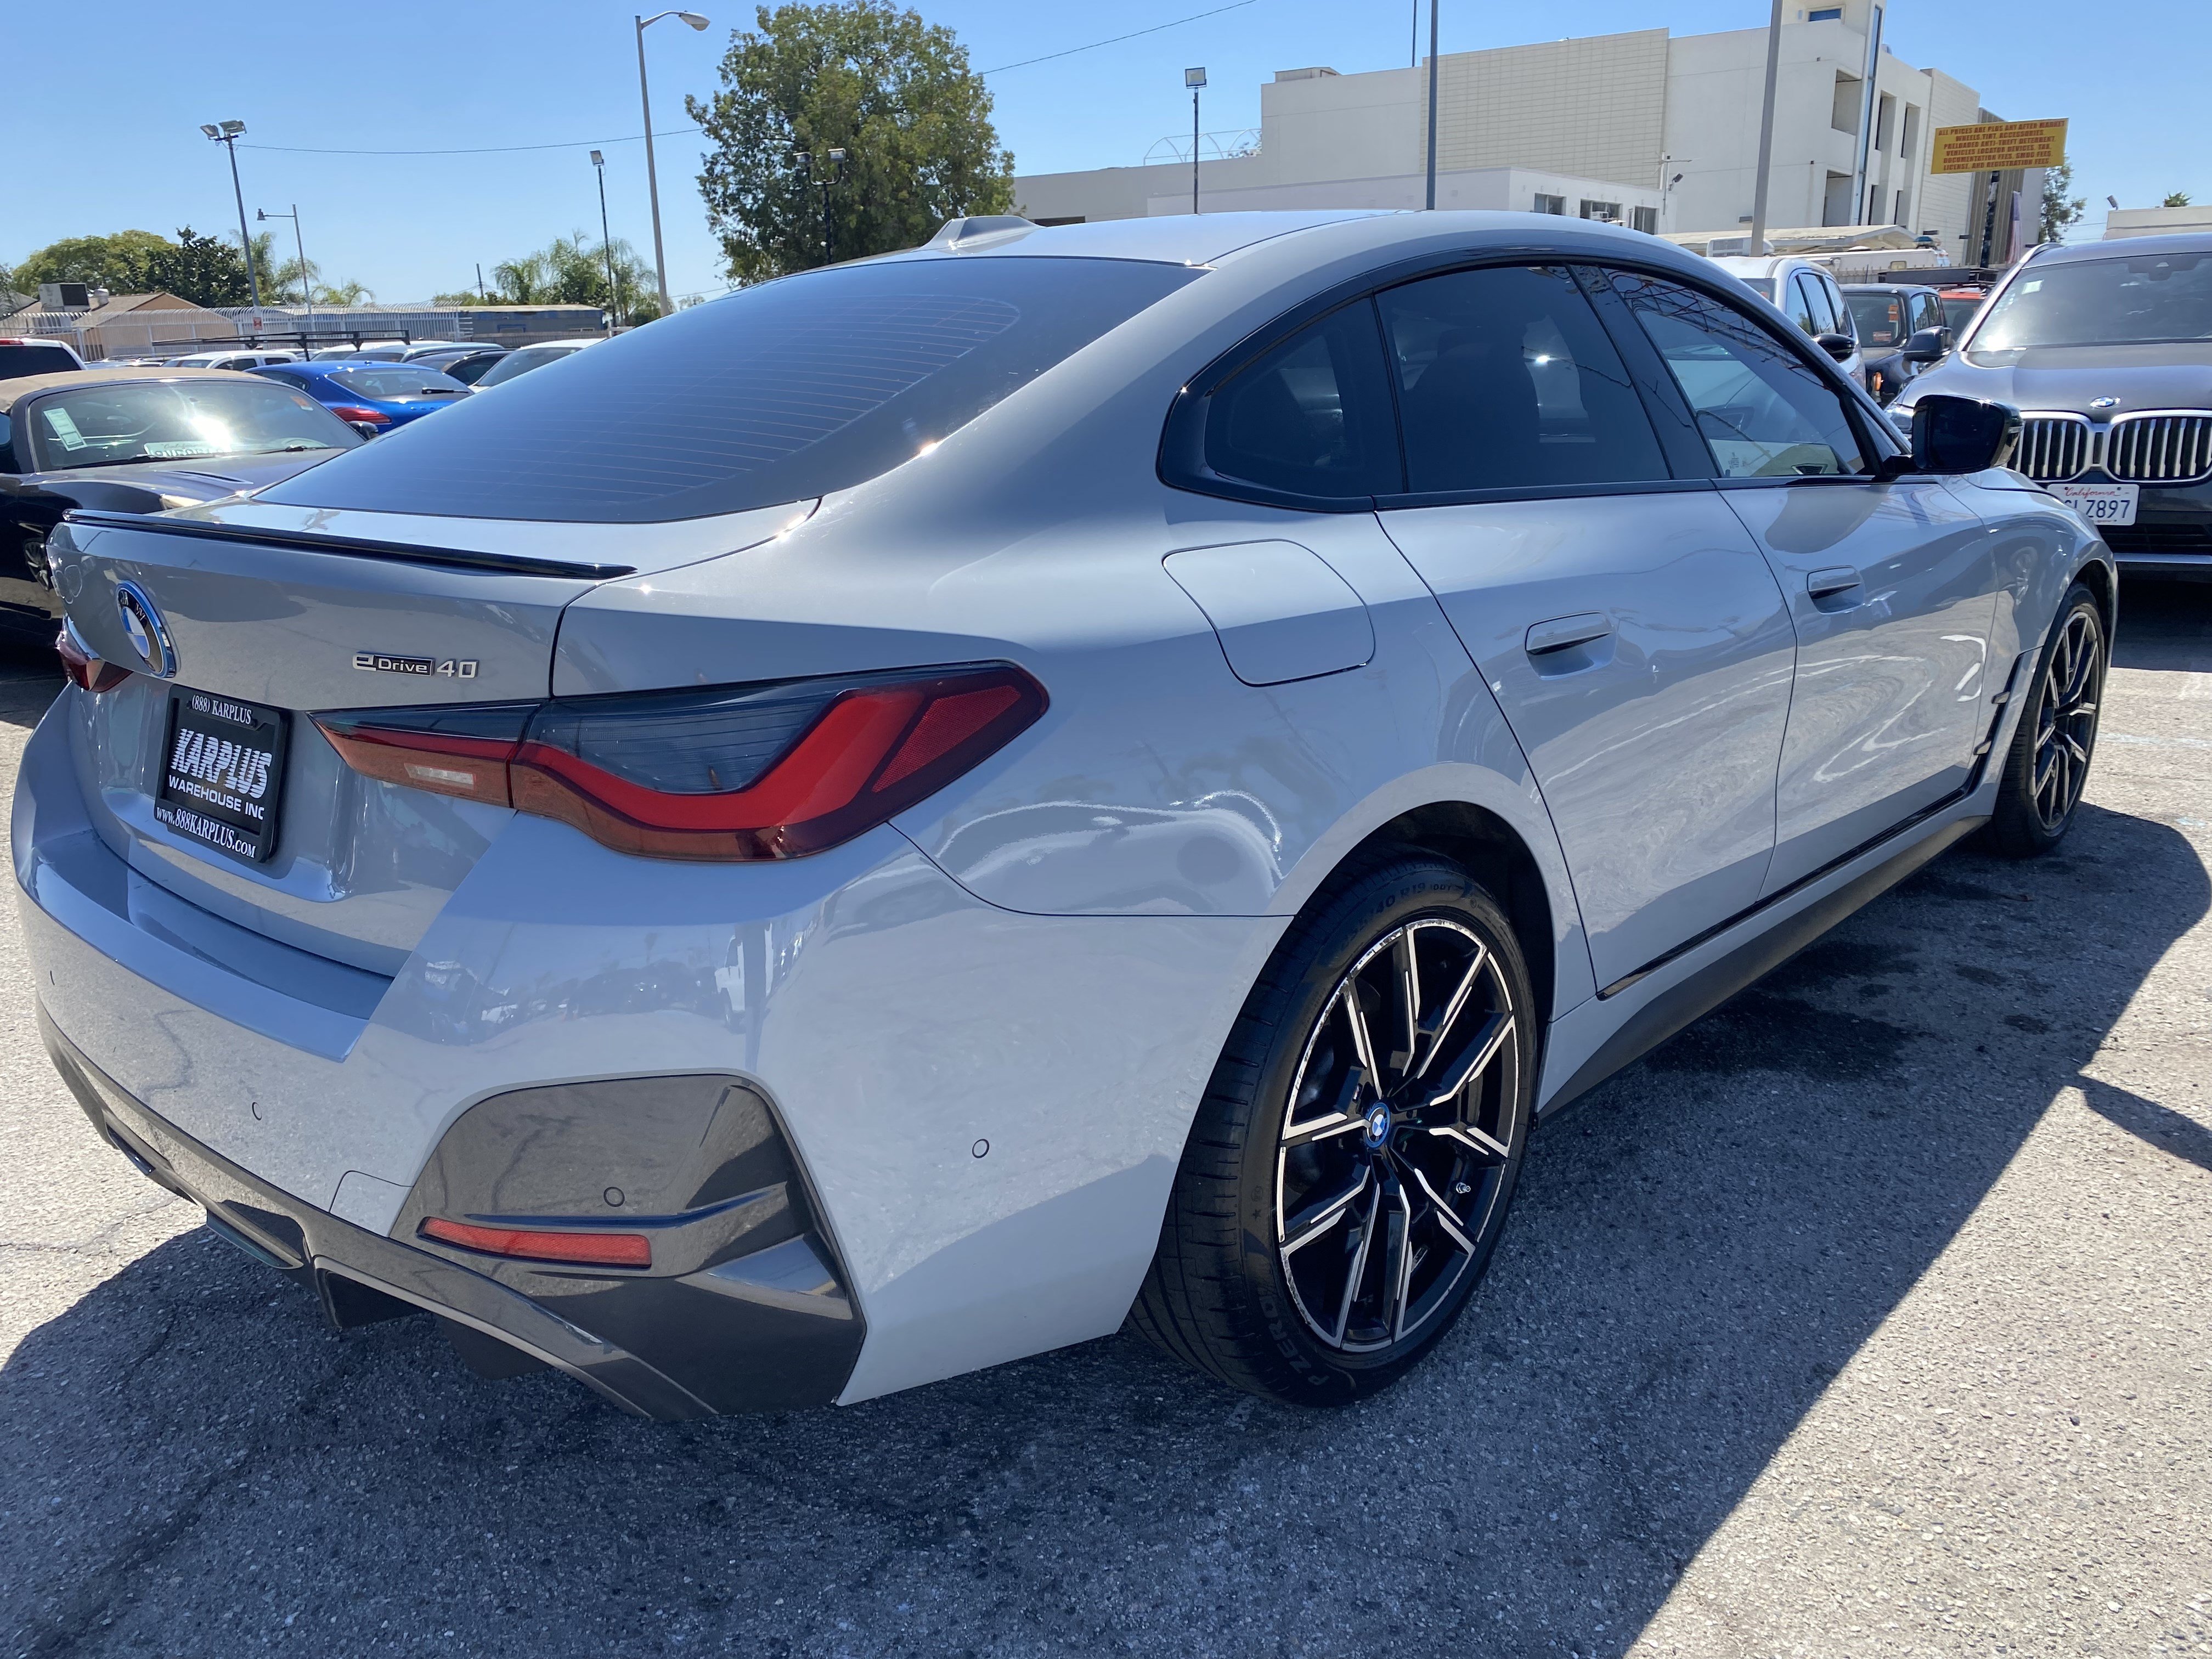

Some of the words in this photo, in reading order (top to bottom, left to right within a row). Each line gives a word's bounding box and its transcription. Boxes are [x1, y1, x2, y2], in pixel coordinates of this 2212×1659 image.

[1987, 159, 2033, 167] REGISTRATION
[2065, 487, 2116, 499] California
[352, 653, 429, 674] eDrive
[436, 659, 478, 679] 40
[192, 694, 211, 713] (888)
[212, 699, 252, 725] KARPLUS
[170, 727, 273, 799] KARPLUS
[168, 774, 242, 812] WAREHOUSE
[245, 802, 265, 820] INC
